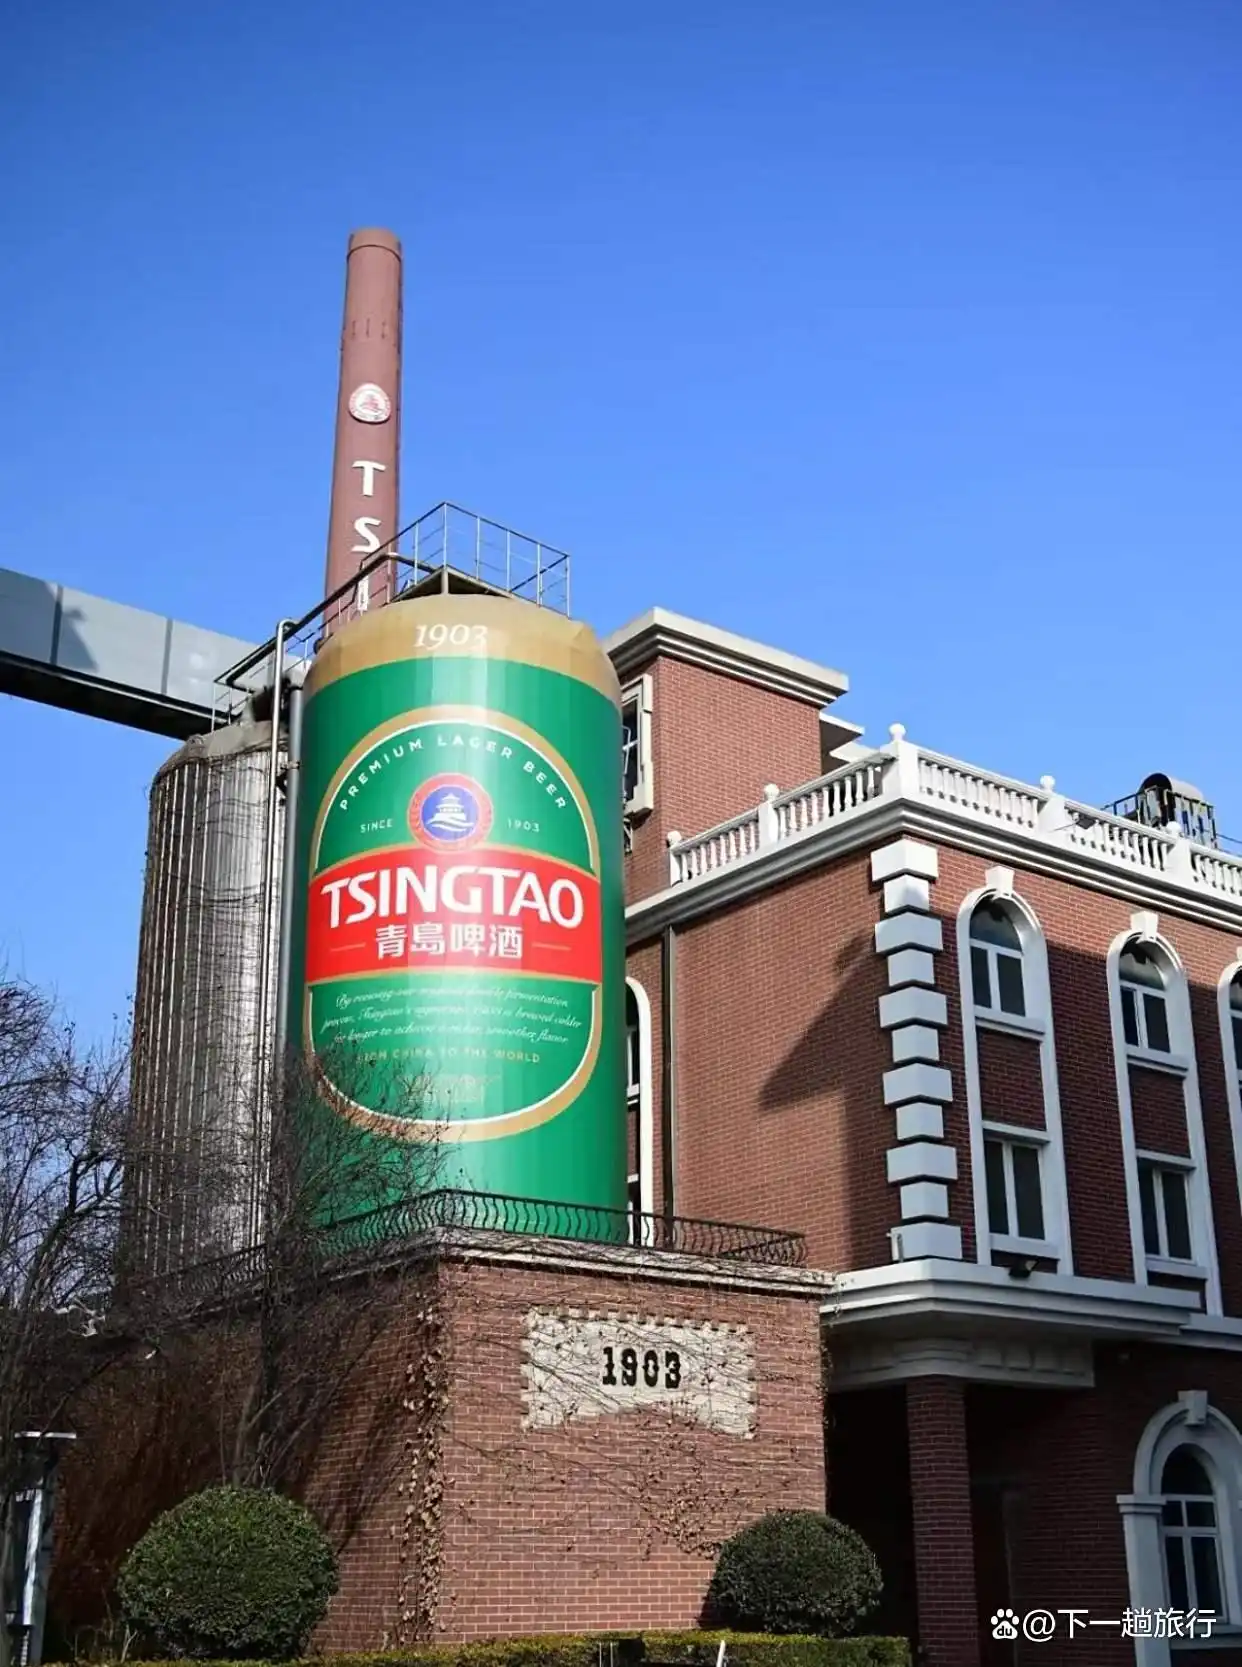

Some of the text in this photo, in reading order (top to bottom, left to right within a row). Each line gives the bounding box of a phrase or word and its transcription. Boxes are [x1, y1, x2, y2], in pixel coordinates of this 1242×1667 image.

[413, 623, 489, 651] 1903
[339, 734, 567, 811] PREMIUM LAGER BEER
[360, 817, 541, 834] SINCE 1903
[320, 864, 584, 929] TSINGTAO
[374, 922, 523, 960] 青島啤酒
[493, 1049, 541, 1063] WORLD
[602, 1346, 682, 1389] 1903
